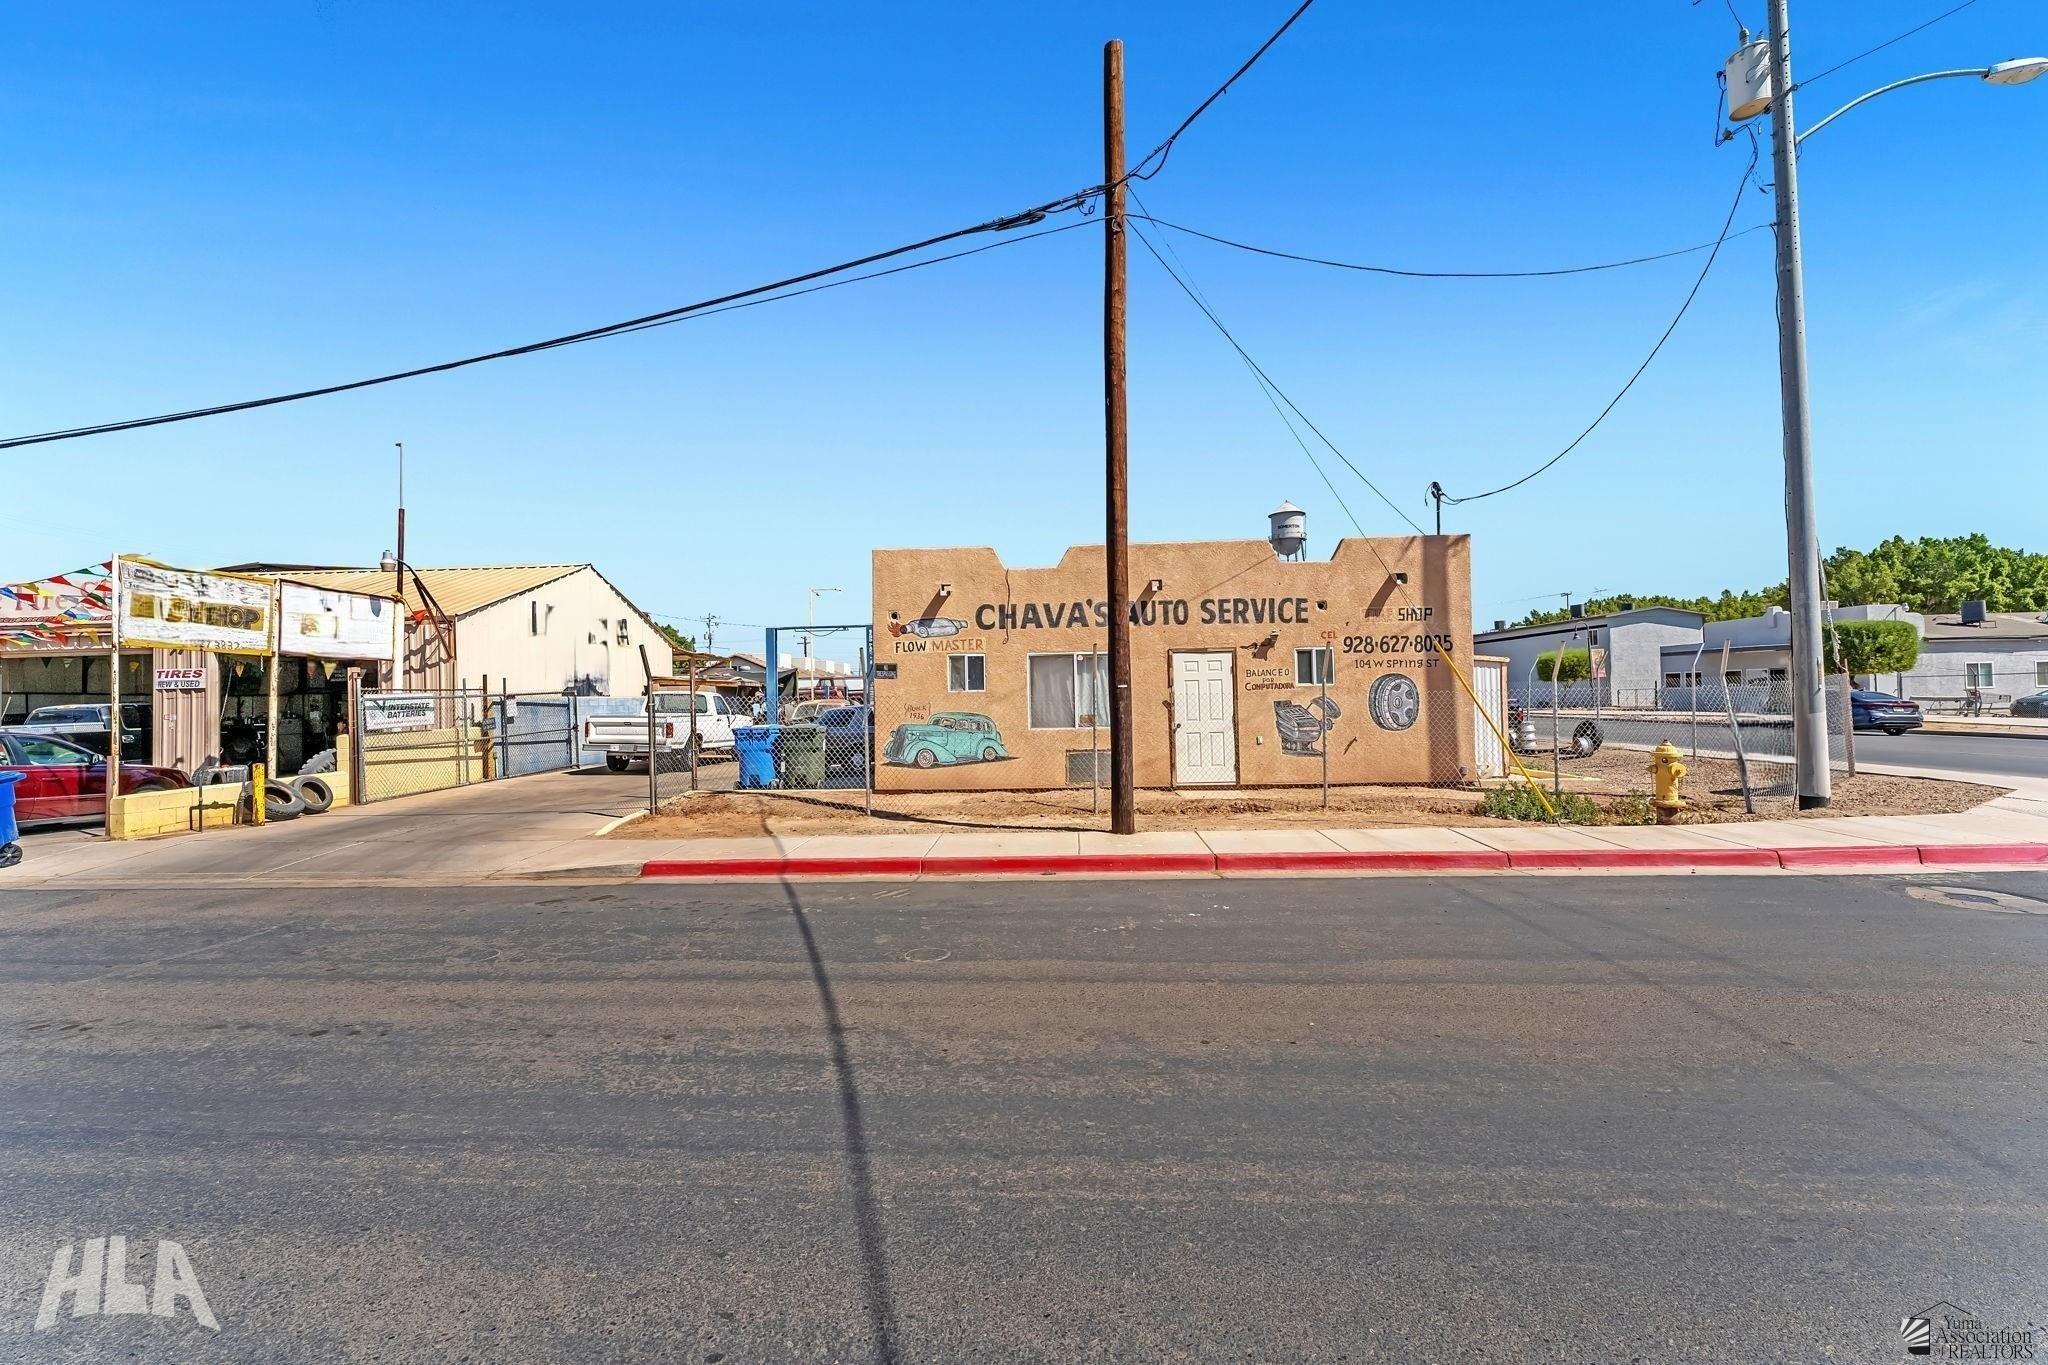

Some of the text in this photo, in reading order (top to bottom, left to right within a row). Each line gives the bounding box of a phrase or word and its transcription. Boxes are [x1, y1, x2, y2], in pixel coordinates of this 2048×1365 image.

[975, 597, 1309, 631] CHAVA'S AUTO SERVICE
[1398, 608, 1433, 621] SHOP
[1321, 631, 1338, 639] CEL
[895, 639, 984, 654] FLOW MASTER
[1355, 659, 1371, 669] 104
[1426, 660, 1440, 668] ST
[156, 670, 203, 679] TIRES
[181, 680, 200, 688] USED
[388, 702, 430, 711] INTERSTATE
[387, 710, 426, 719] BATTERIES
